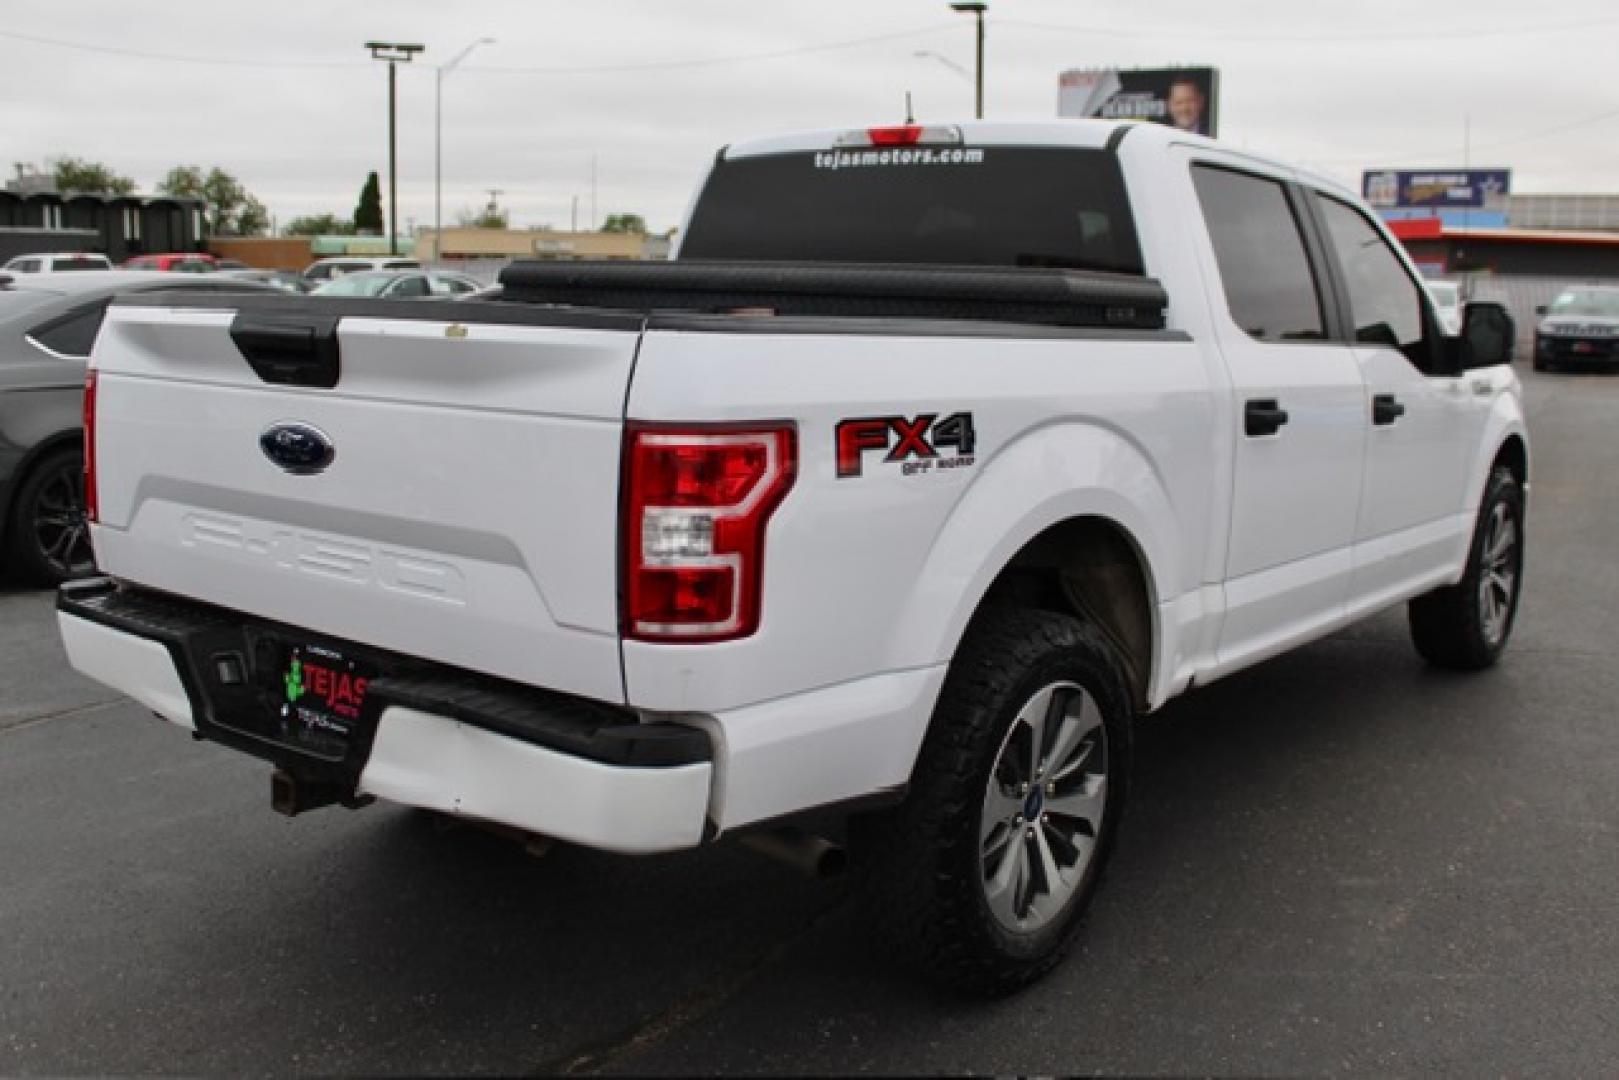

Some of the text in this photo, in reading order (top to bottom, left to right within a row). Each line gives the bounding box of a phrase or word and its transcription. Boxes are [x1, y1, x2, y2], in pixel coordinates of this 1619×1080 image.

[814, 149, 984, 169] tejasmotors.com
[835, 411, 976, 479] FX4
[902, 459, 932, 476] OFF
[181, 510, 467, 606] F-150
[303, 662, 367, 708] TEJAS
